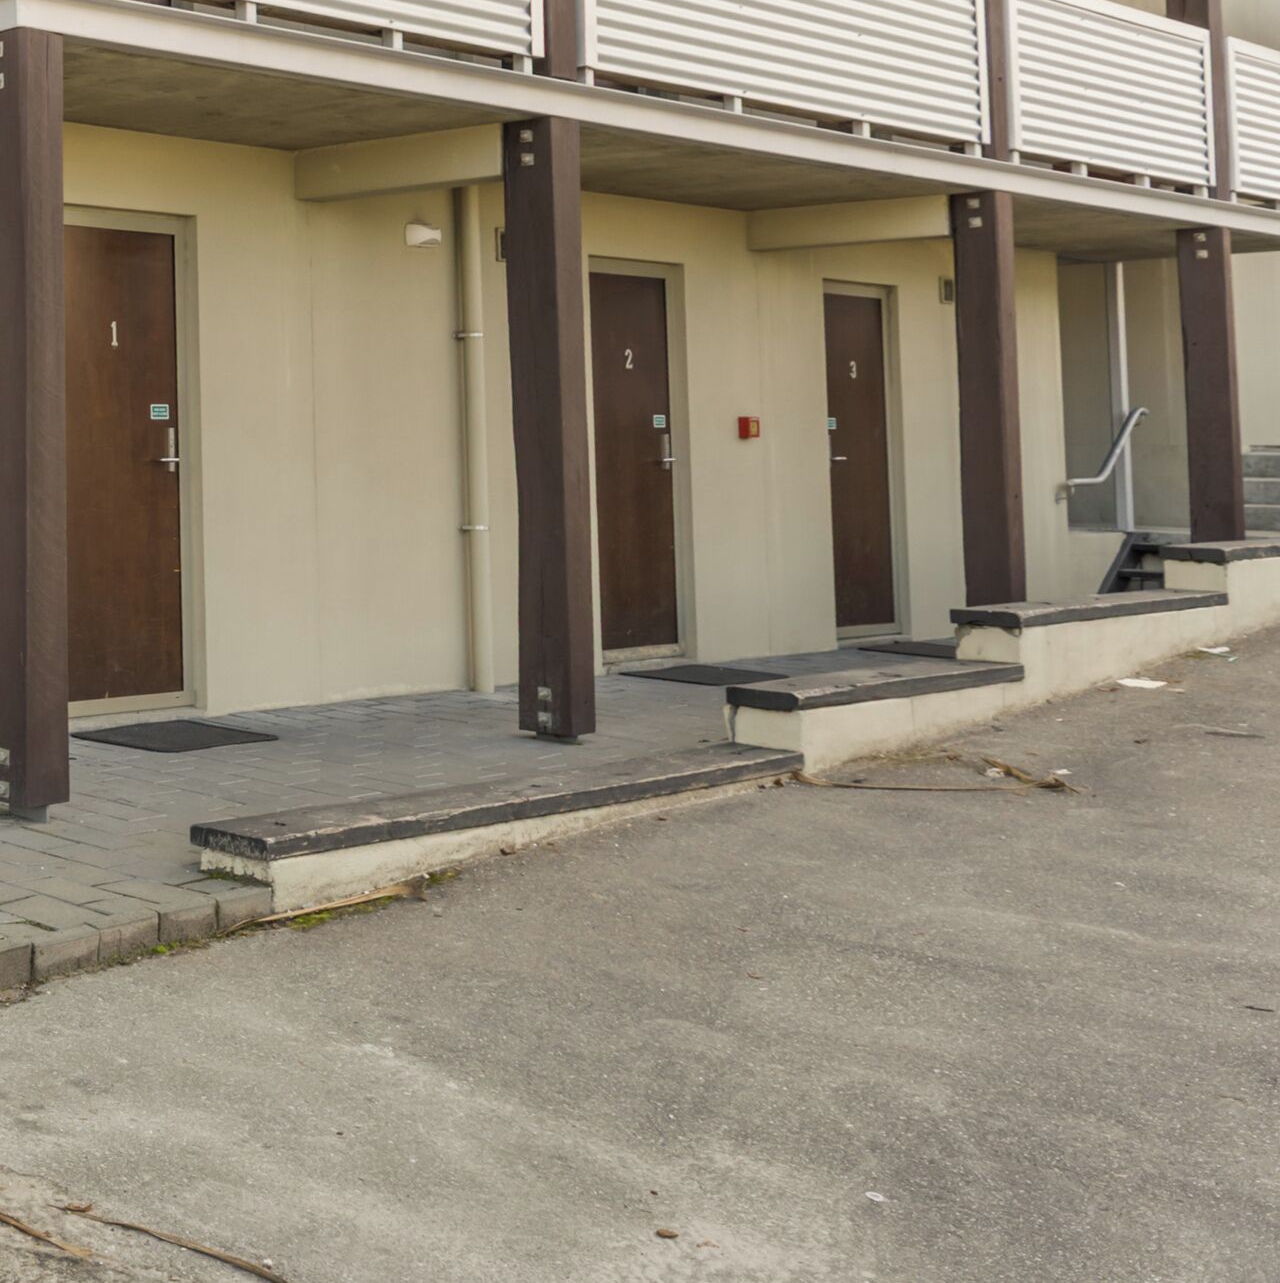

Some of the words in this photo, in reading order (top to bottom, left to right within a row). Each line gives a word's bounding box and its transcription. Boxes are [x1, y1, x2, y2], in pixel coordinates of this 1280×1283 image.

[110, 320, 119, 347] 1
[624, 348, 634, 369] 2
[849, 360, 857, 379] 3
